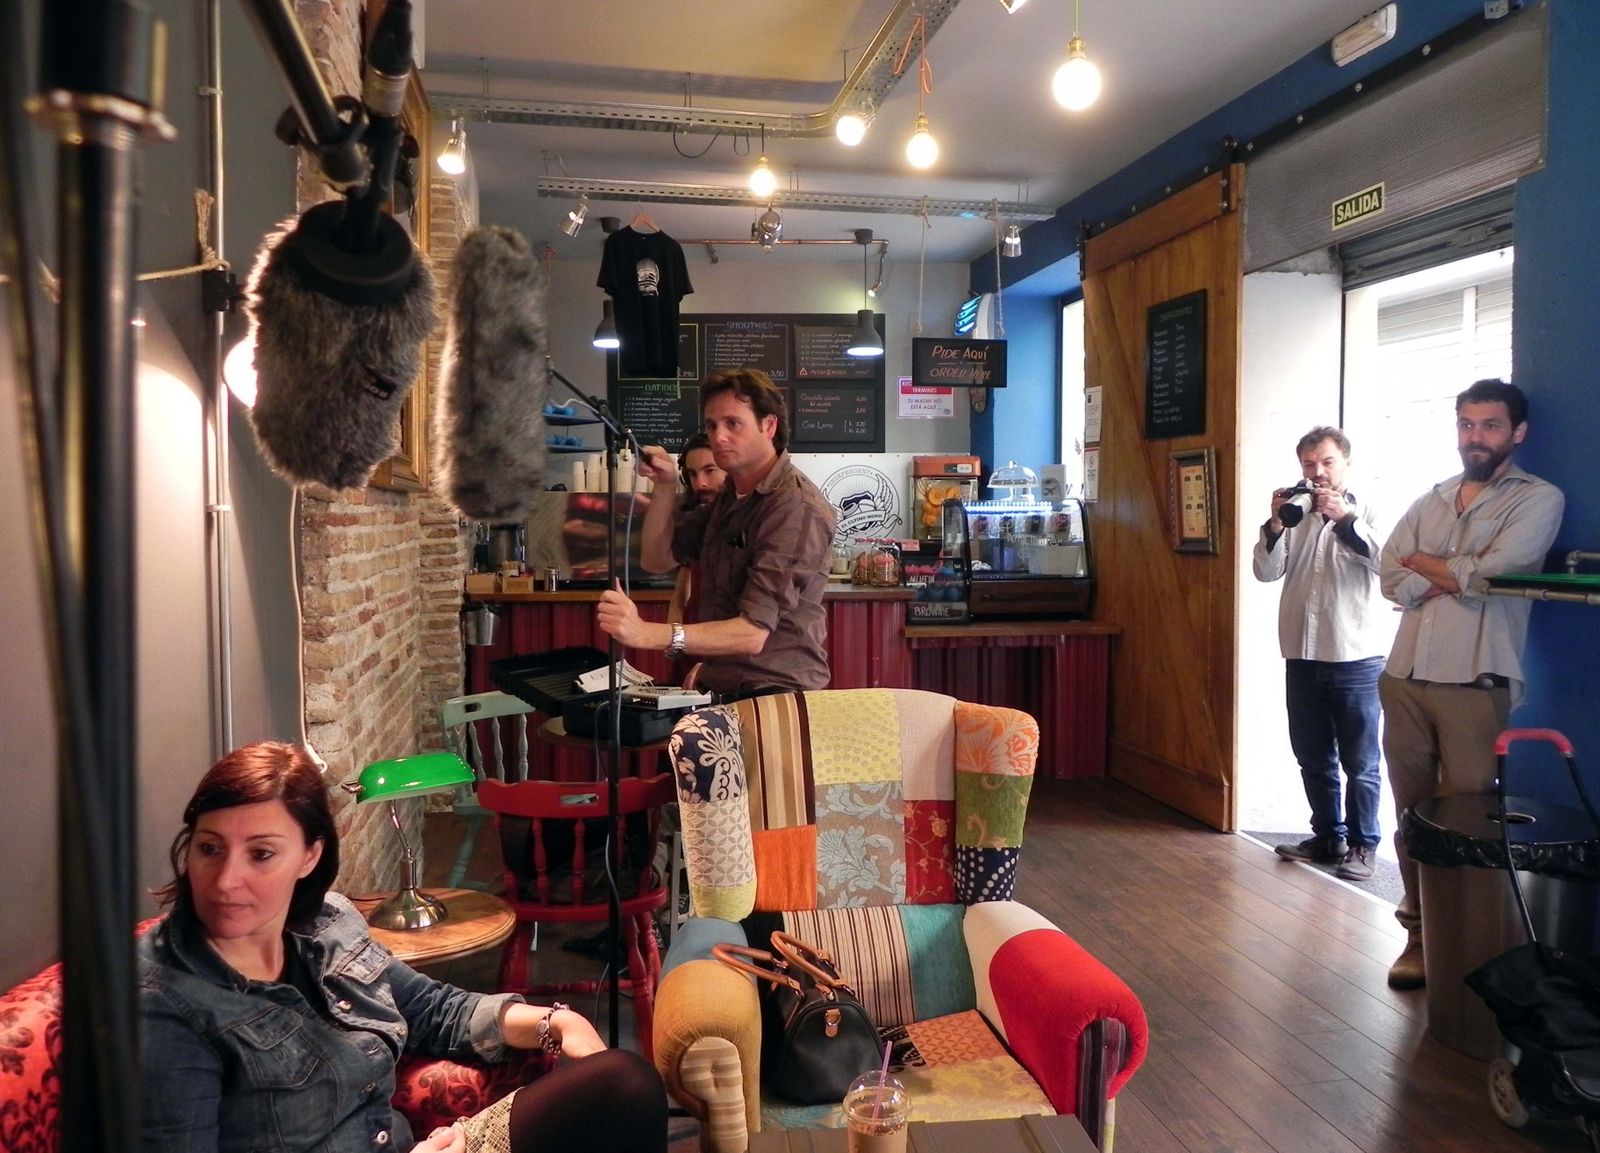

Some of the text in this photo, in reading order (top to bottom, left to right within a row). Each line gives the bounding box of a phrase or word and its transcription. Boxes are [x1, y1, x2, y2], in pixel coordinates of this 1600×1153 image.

[1336, 190, 1380, 223] SALIDA
[931, 345, 961, 359] PIDE
[930, 367, 967, 378] ORDER
[914, 606, 950, 617] BROWNIE
